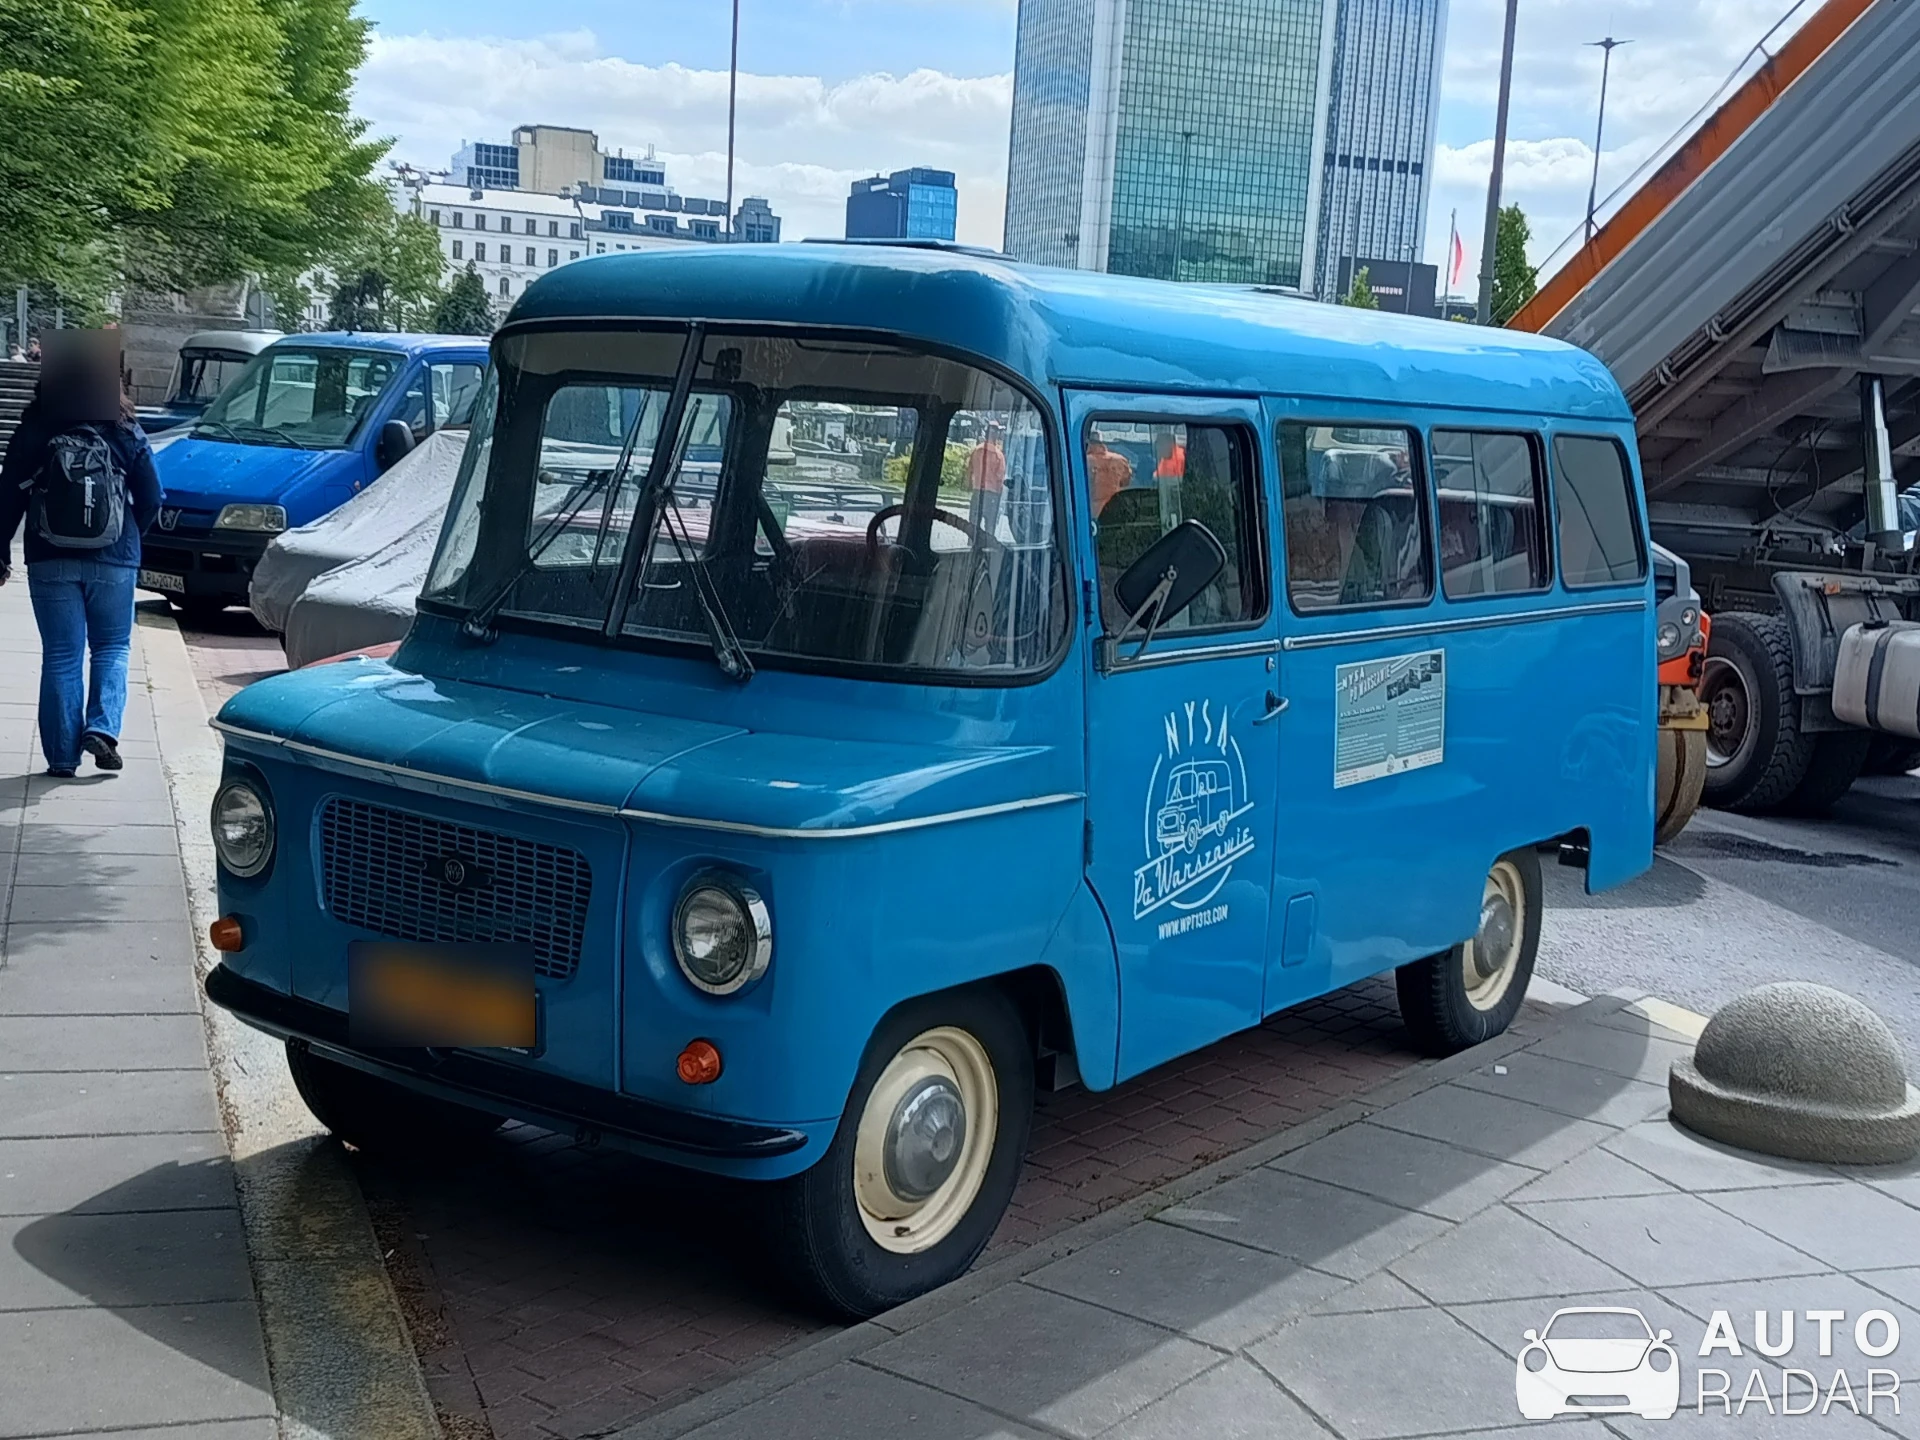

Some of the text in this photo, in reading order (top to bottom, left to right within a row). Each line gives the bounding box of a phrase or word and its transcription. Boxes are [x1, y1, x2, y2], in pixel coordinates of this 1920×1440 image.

[1371, 286, 1403, 295] SAMSUNG
[1341, 666, 1366, 690] NYSA
[1164, 698, 1228, 760] NYSA
[1155, 827, 1254, 898] Warszawie
